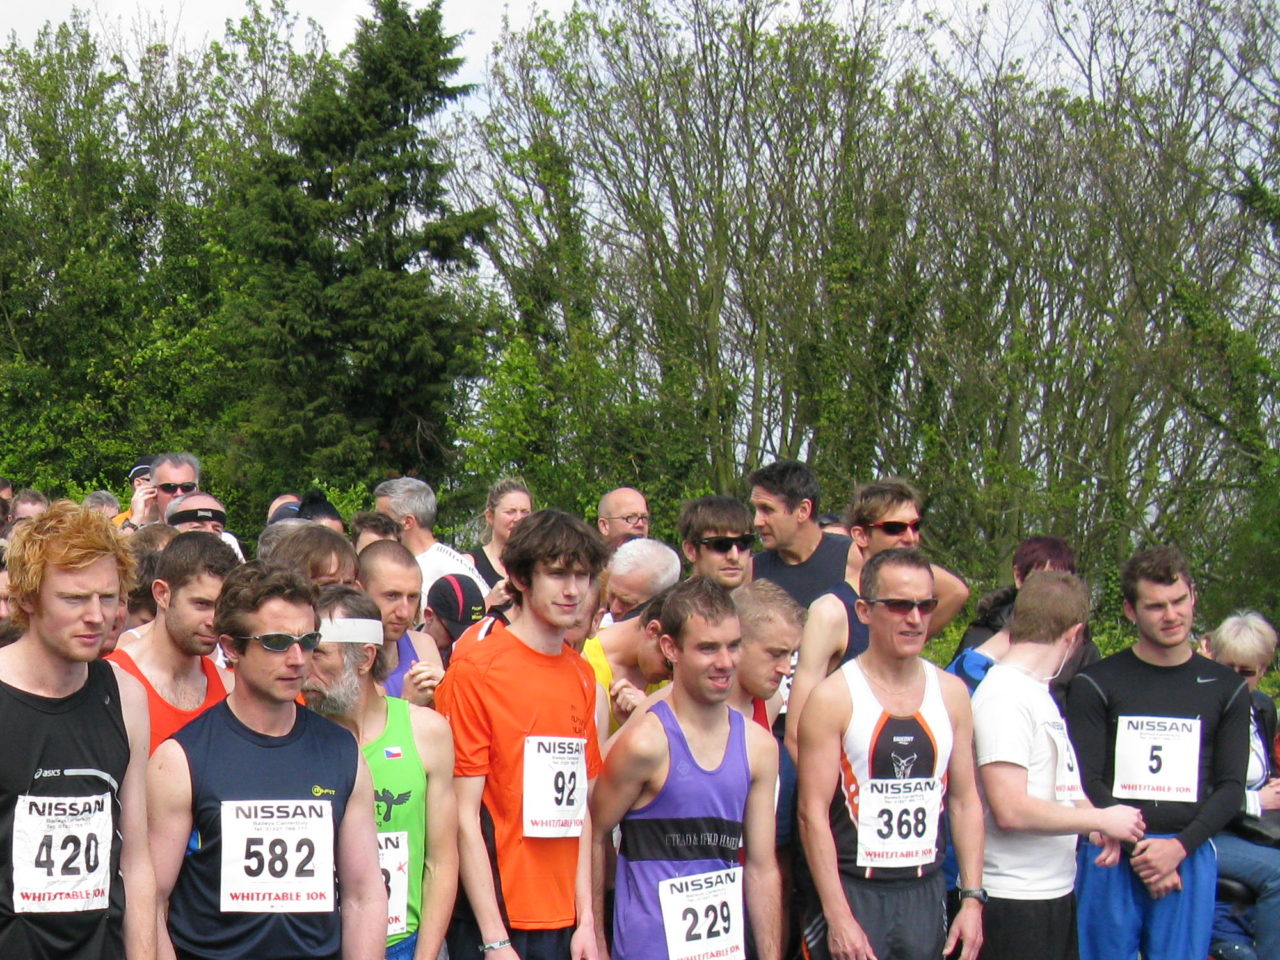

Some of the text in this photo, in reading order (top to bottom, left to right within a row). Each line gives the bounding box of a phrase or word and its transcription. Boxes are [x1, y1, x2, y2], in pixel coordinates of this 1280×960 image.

[1127, 720, 1193, 733] NISSAN
[1148, 745, 1163, 774] 5
[554, 770, 577, 806] 92
[870, 781, 936, 794] NISSAN
[1121, 783, 1172, 793] WHITSTABLE
[28, 799, 105, 817] NISSAN
[235, 805, 324, 820] NISSAN
[530, 819, 572, 829] WHITSTABLE
[877, 807, 927, 839] 368
[35, 832, 100, 877] 420
[244, 837, 315, 879] 582
[865, 848, 920, 860] WHITSTABLE
[670, 871, 736, 895] NISSAN
[20, 889, 90, 902] WHITSTABLE
[229, 890, 327, 901] WHITSTABLE 10K
[682, 900, 731, 942] 229
